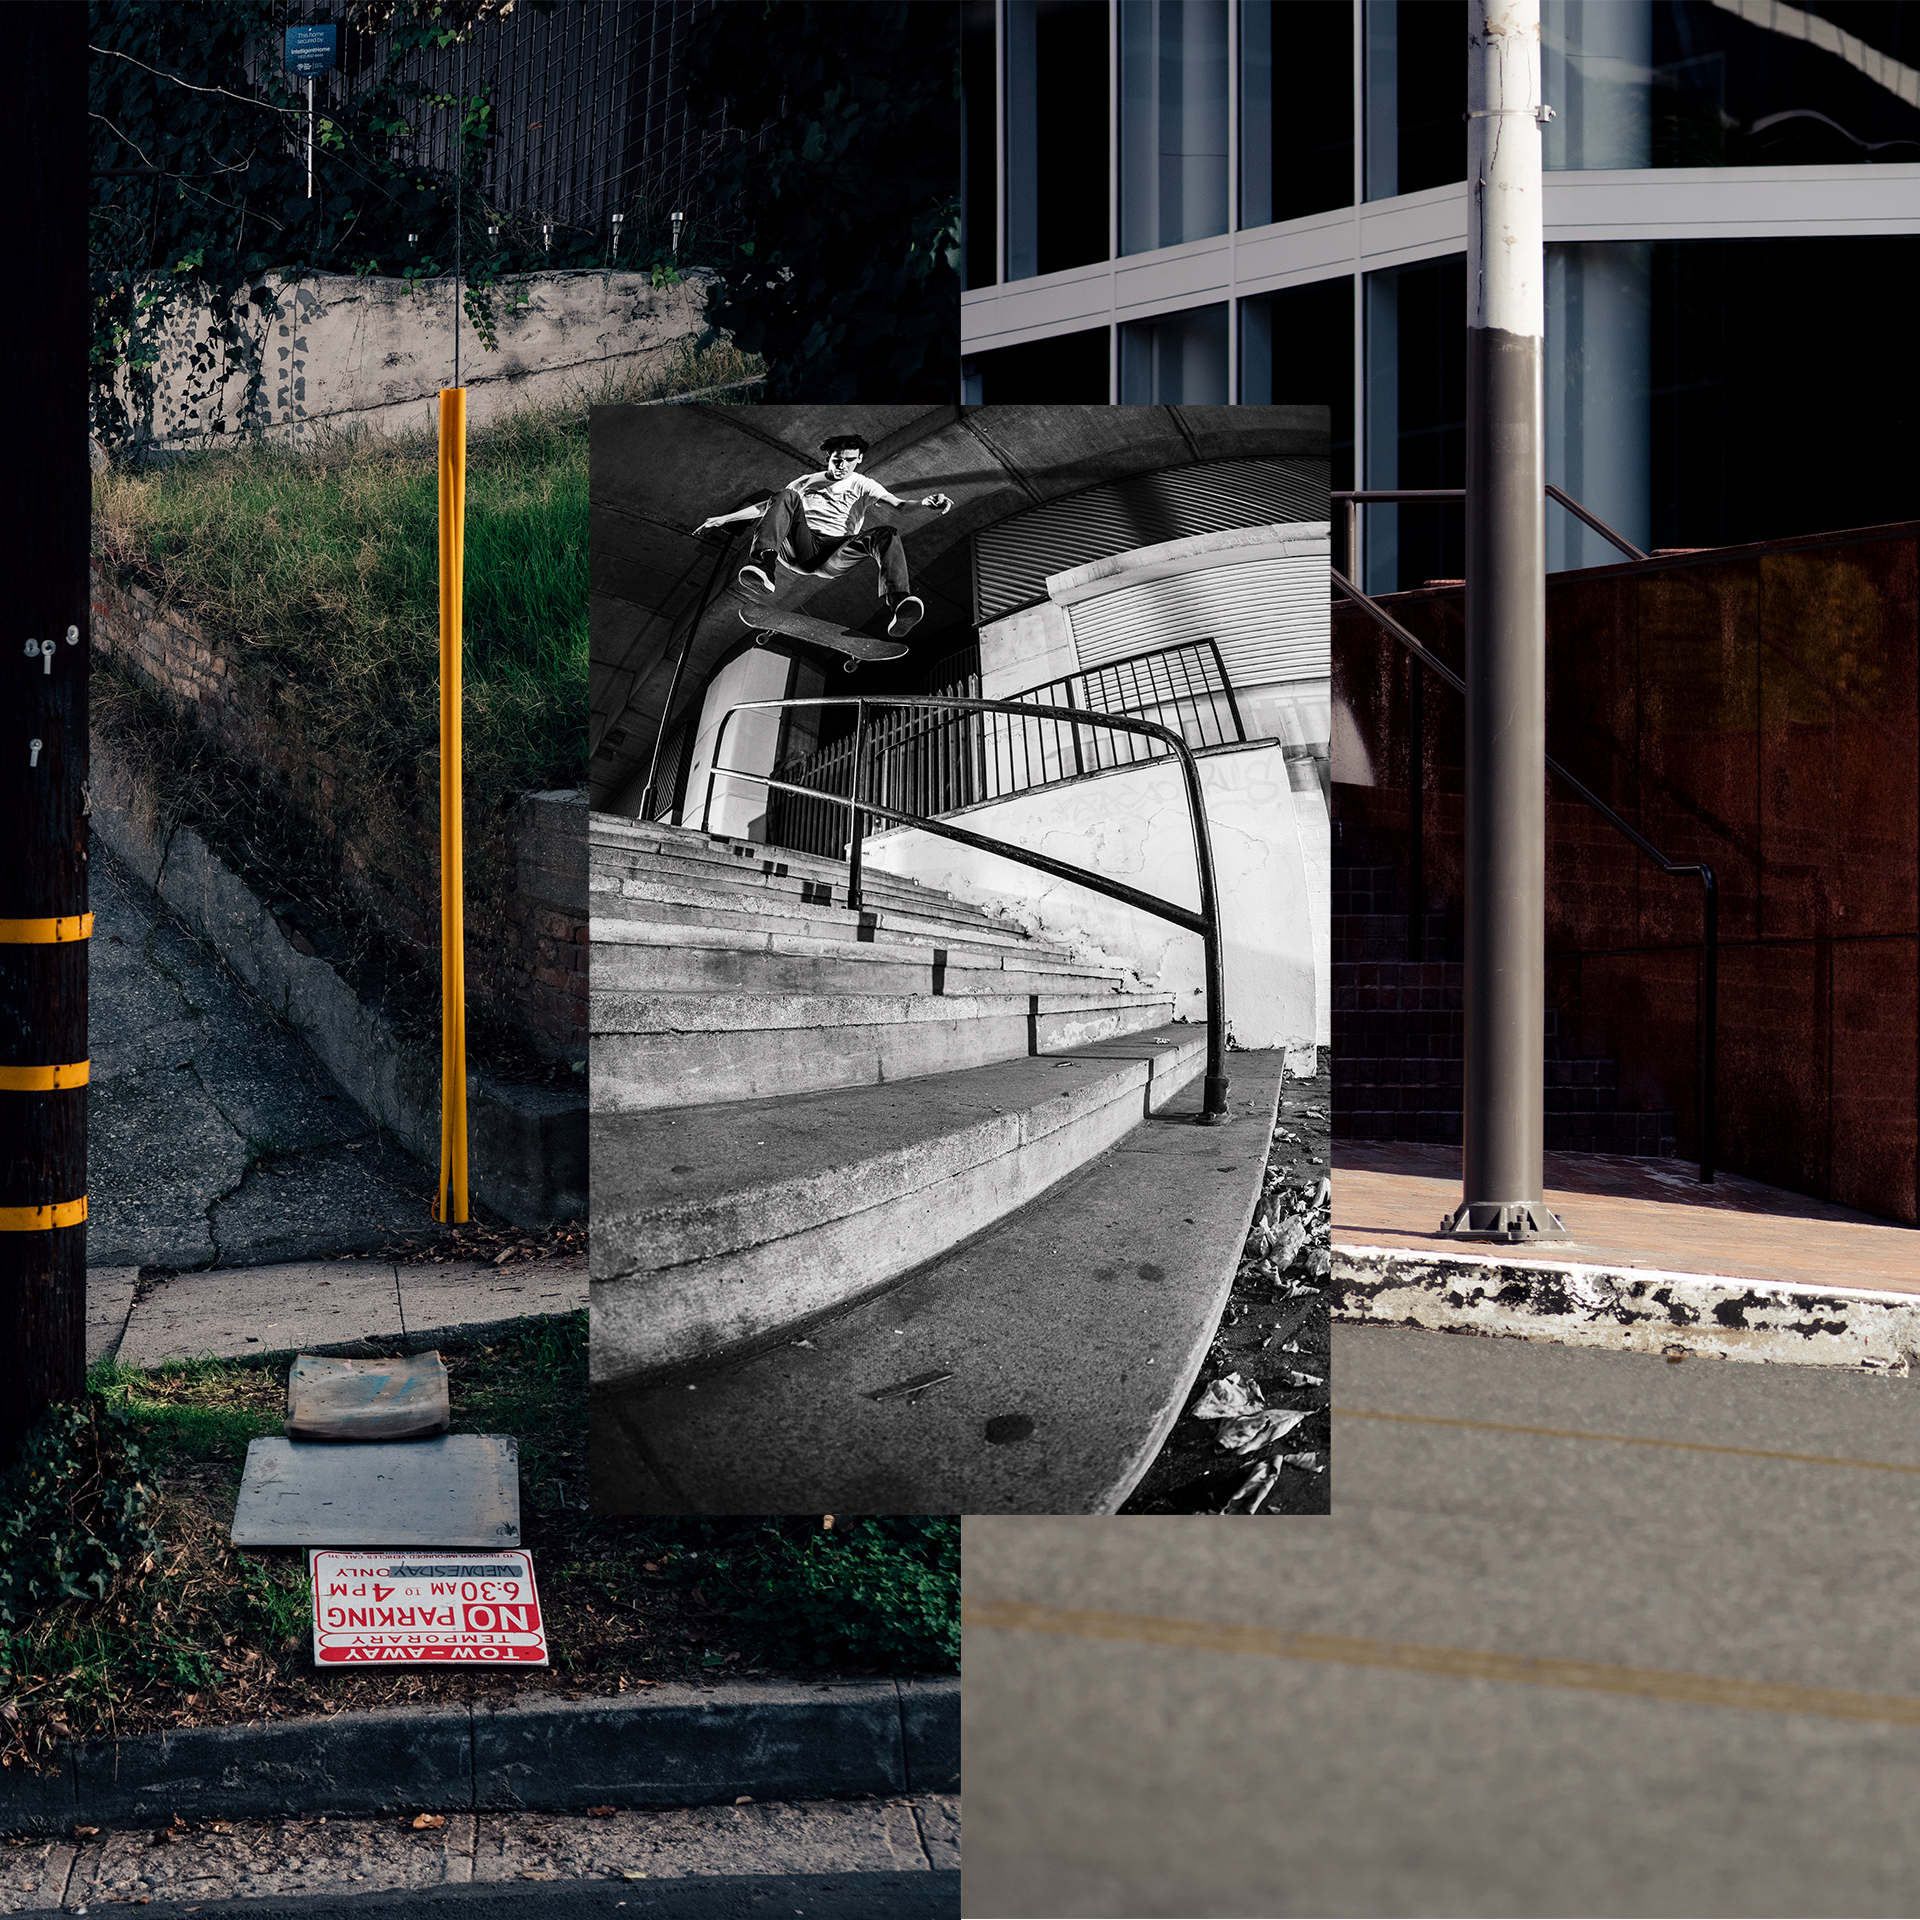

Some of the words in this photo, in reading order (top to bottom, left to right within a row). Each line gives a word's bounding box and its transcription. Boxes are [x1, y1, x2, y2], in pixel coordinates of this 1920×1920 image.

[336, 1568, 390, 1577] ONLY
[394, 1561, 516, 1577] WEDNESDAY
[330, 1583, 366, 1596] PM
[373, 1583, 395, 1602] 4
[405, 1587, 420, 1596] TO
[430, 1582, 457, 1595] AM
[461, 1581, 519, 1601] 6:30
[327, 1606, 455, 1627] PARKING
[467, 1606, 529, 1631] NO
[351, 1634, 510, 1644] TEMPORARY
